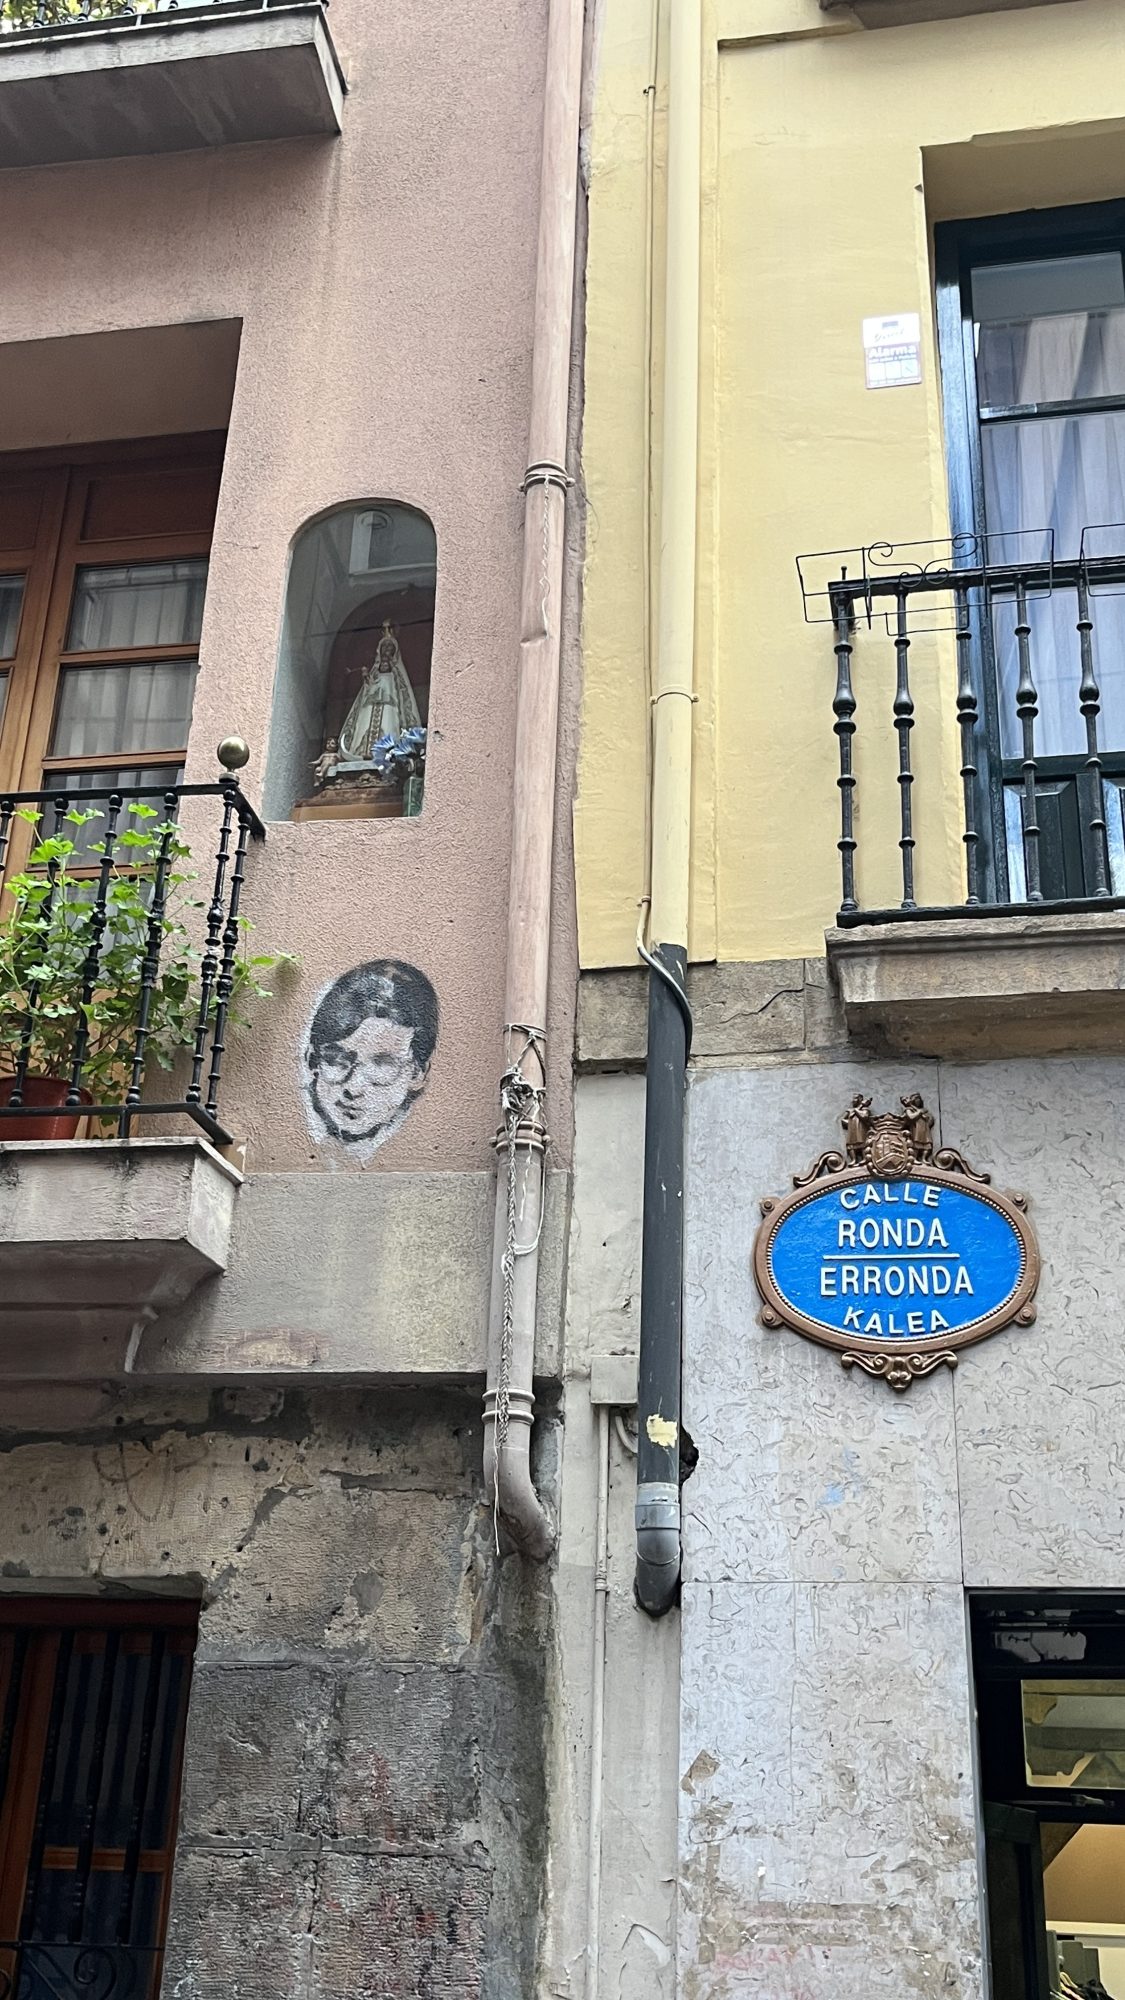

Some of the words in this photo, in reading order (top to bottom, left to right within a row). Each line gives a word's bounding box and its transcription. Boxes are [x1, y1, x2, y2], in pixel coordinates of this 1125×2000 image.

[840, 1183, 941, 1209] CALLE
[838, 1218, 949, 1248] RONDA
[820, 1265, 974, 1296] ERRONDA
[843, 1306, 949, 1334] KALEA
